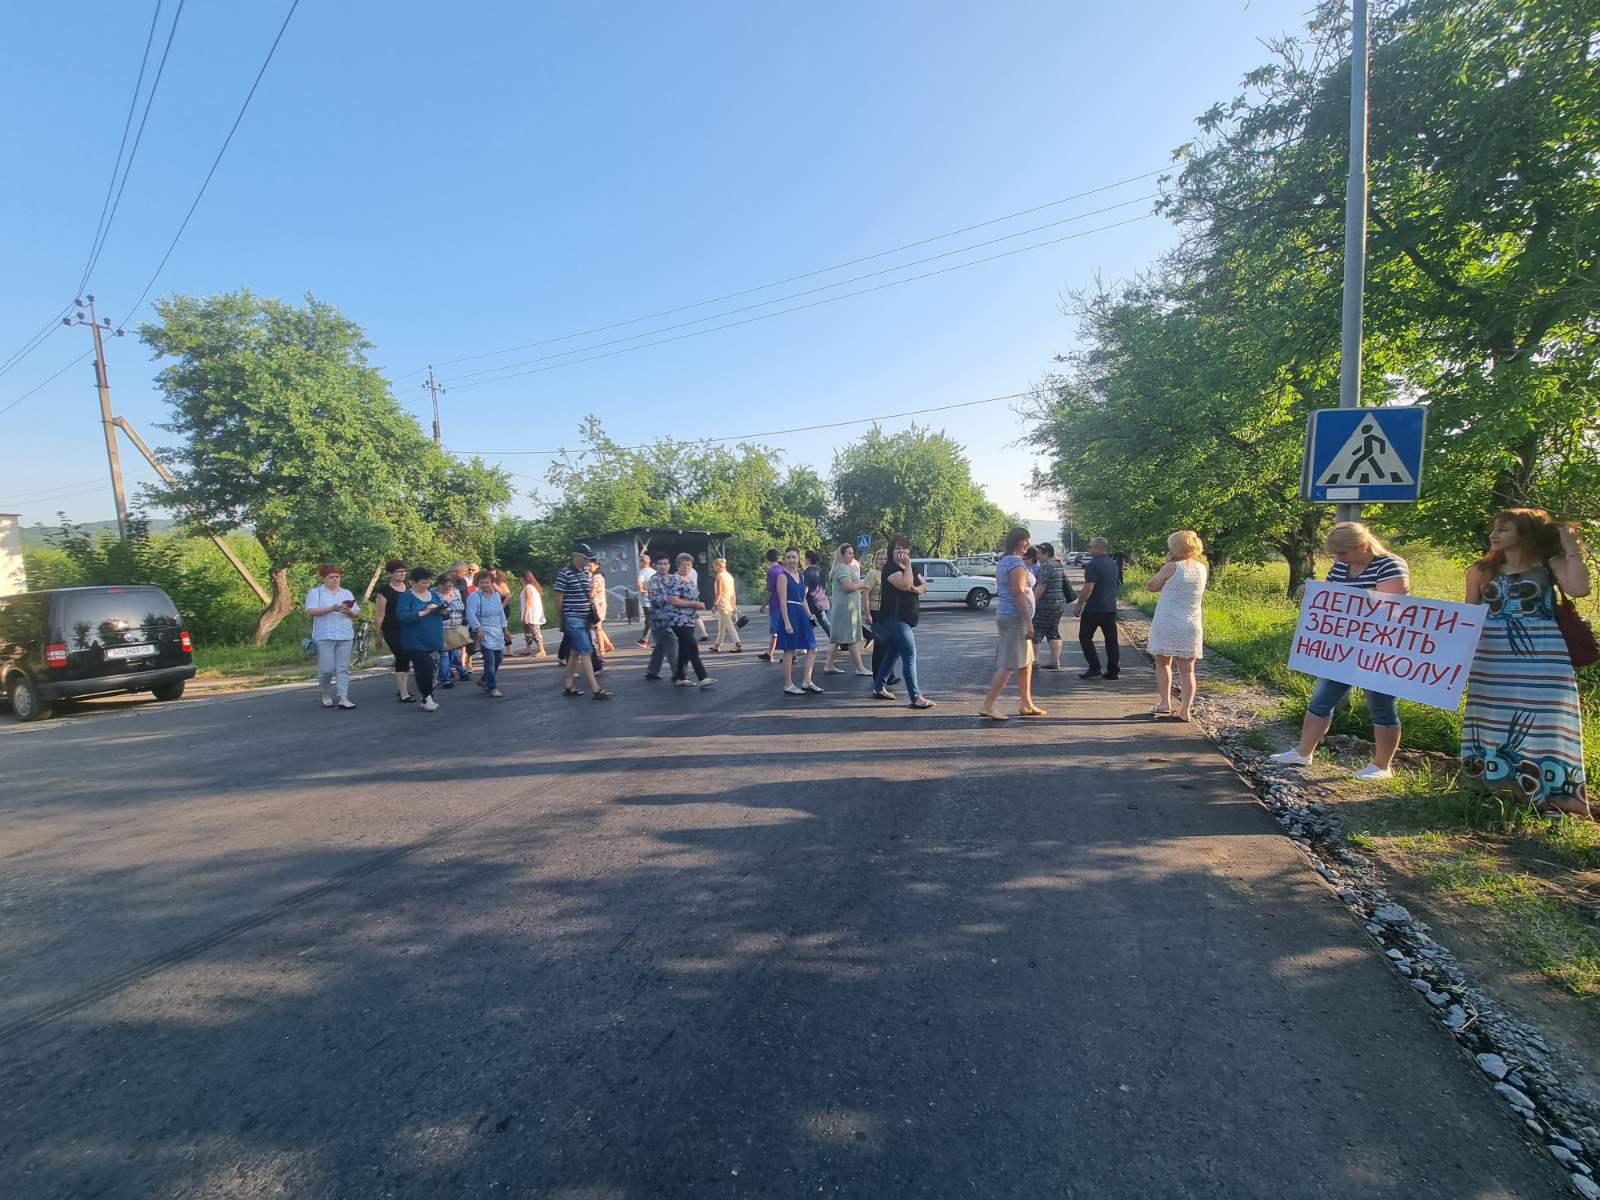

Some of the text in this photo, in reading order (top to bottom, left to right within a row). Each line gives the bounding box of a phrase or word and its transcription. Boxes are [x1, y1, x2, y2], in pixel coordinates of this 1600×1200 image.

[1305, 612, 1436, 654] ЗБЕРЕЖІТЬ
[1296, 636, 1462, 690] НАШУ ШКОЛУ!
